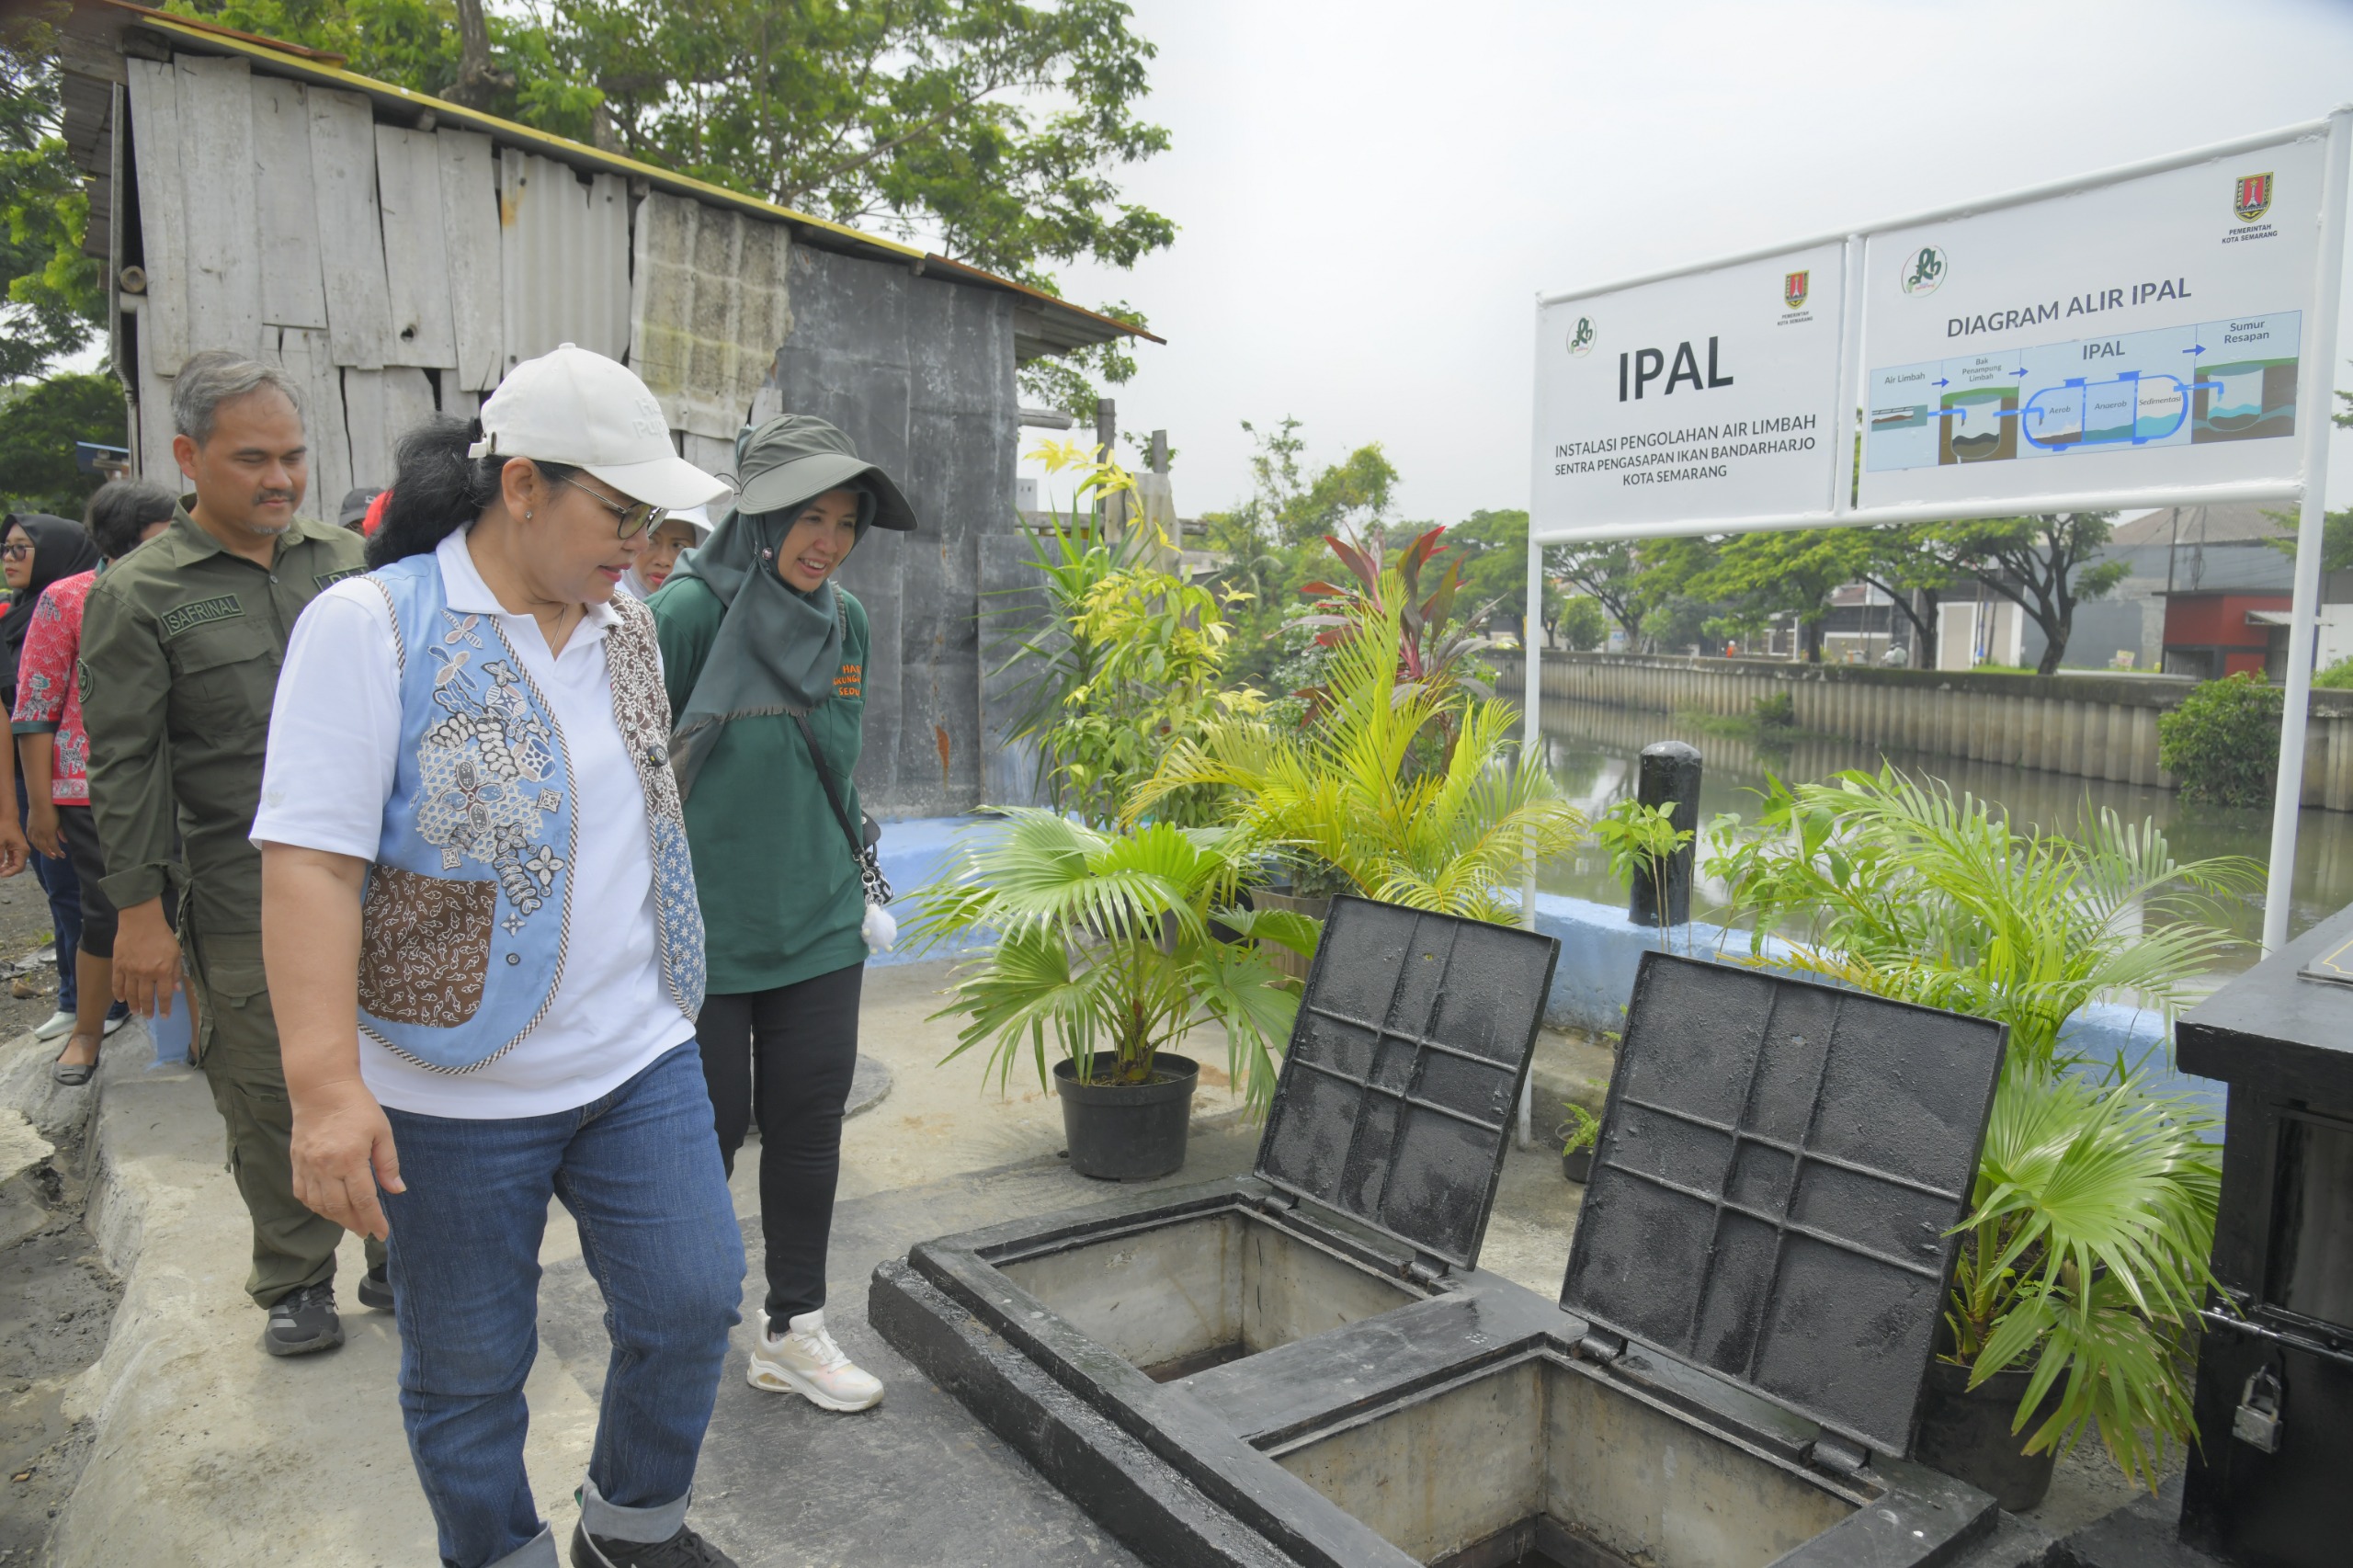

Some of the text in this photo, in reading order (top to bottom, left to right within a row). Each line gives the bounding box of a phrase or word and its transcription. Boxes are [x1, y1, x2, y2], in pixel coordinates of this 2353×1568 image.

[2229, 223, 2272, 235] PEMERINTAH
[2222, 230, 2278, 244] KOTA SEMARANG
[1947, 277, 2192, 338] DIAGRAM ALIR IPAL
[2229, 320, 2266, 332] Sumur
[2223, 332, 2270, 345] Resapan
[2082, 340, 2126, 360] IPAL
[1619, 335, 1734, 403] IPAL
[1961, 364, 2002, 375] Penampung
[1884, 372, 1926, 385] Air Limbah
[1969, 373, 1994, 382] Limbah
[2094, 400, 2127, 410] Anaerob
[2138, 394, 2182, 406] Sedimentasi
[2049, 405, 2071, 415] Aerob
[1555, 414, 1816, 459] INSTALASI PENGOLAHAN AIR LIMBAH
[1554, 437, 1816, 476] SENTRA PENGASAPAN IKAN BANDARHARJO
[1623, 465, 1727, 486] KOTA SEMARANG
[168, 597, 241, 631] SAFRINAL
